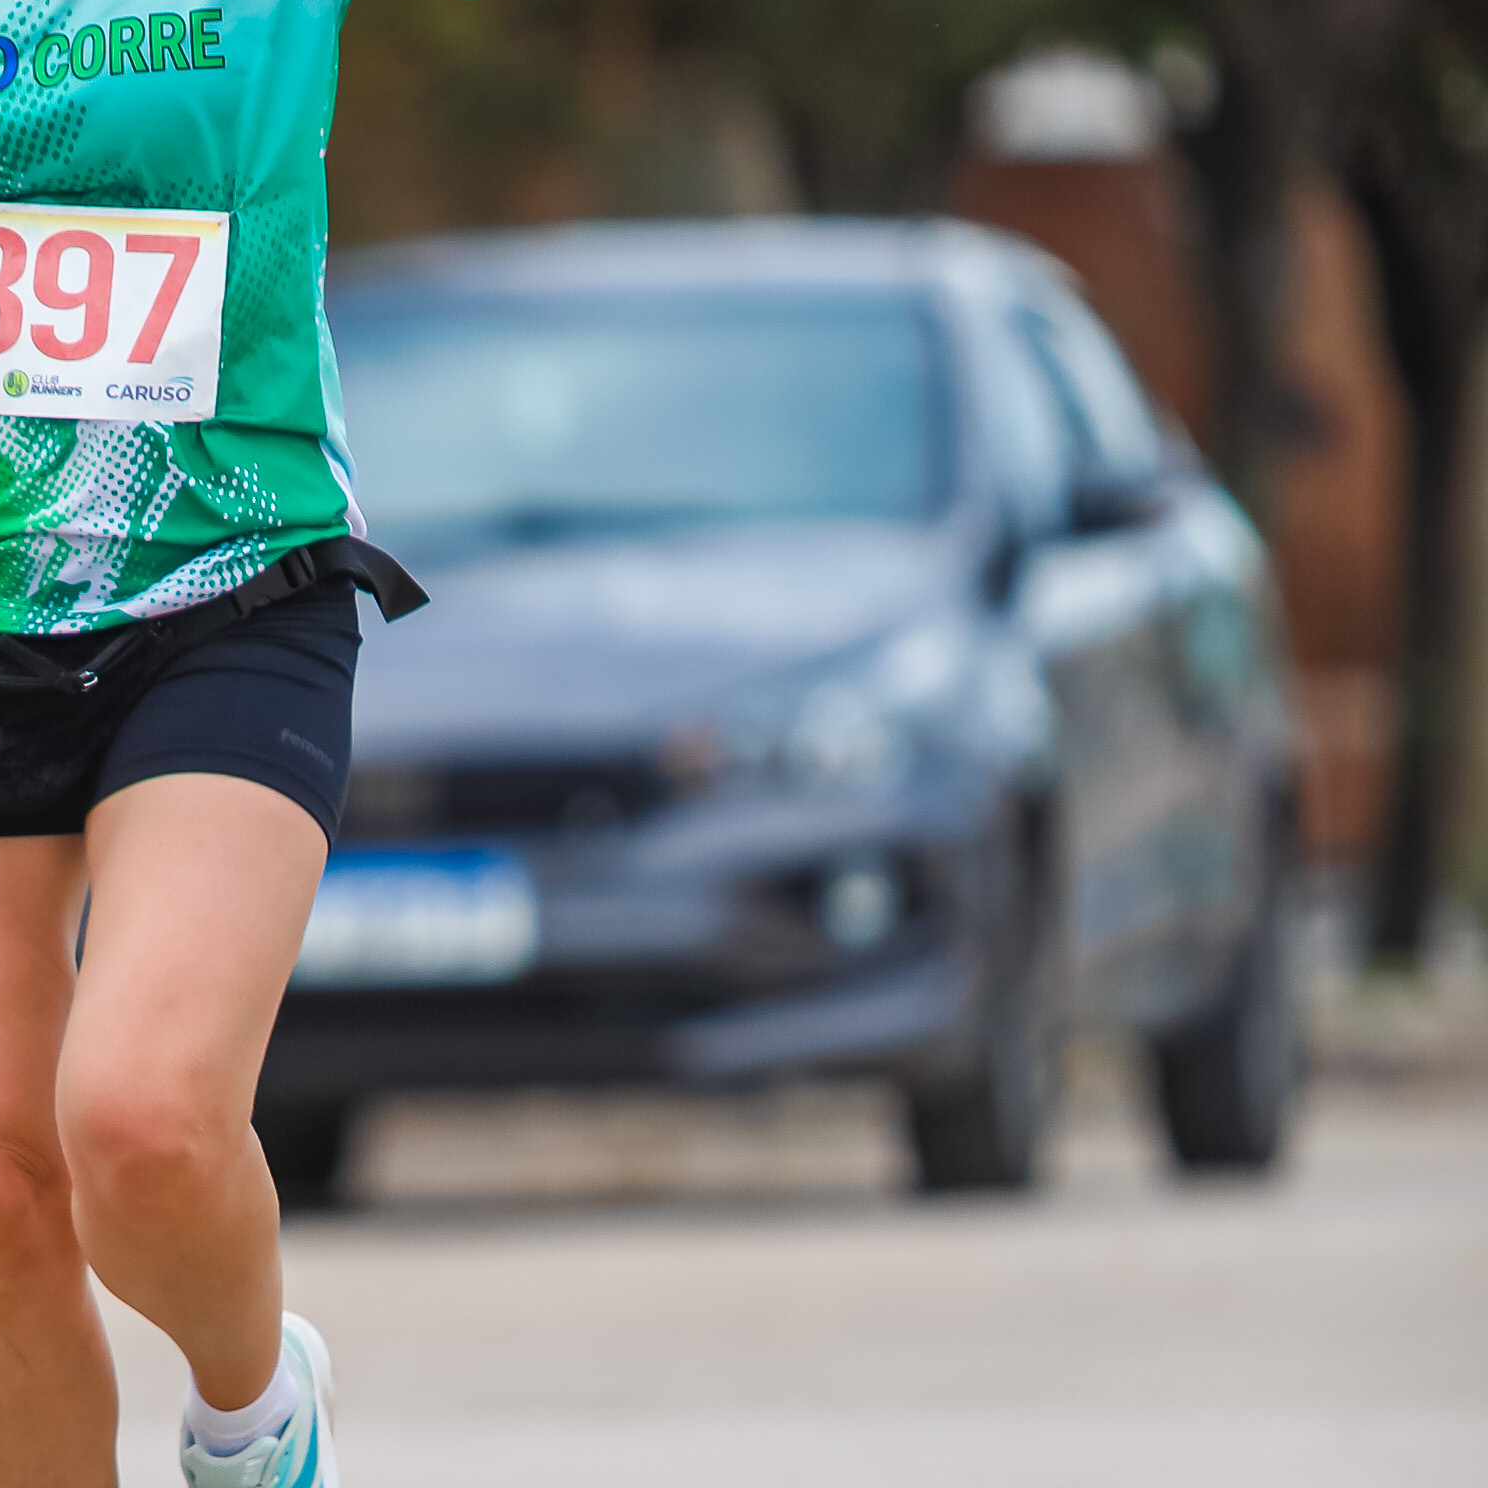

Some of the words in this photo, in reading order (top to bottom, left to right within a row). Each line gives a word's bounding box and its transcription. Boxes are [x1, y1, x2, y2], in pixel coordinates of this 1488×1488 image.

[32, 8, 225, 88] CORRE
[31, 374, 60, 385] CLUB
[106, 383, 191, 402] CARUSO
